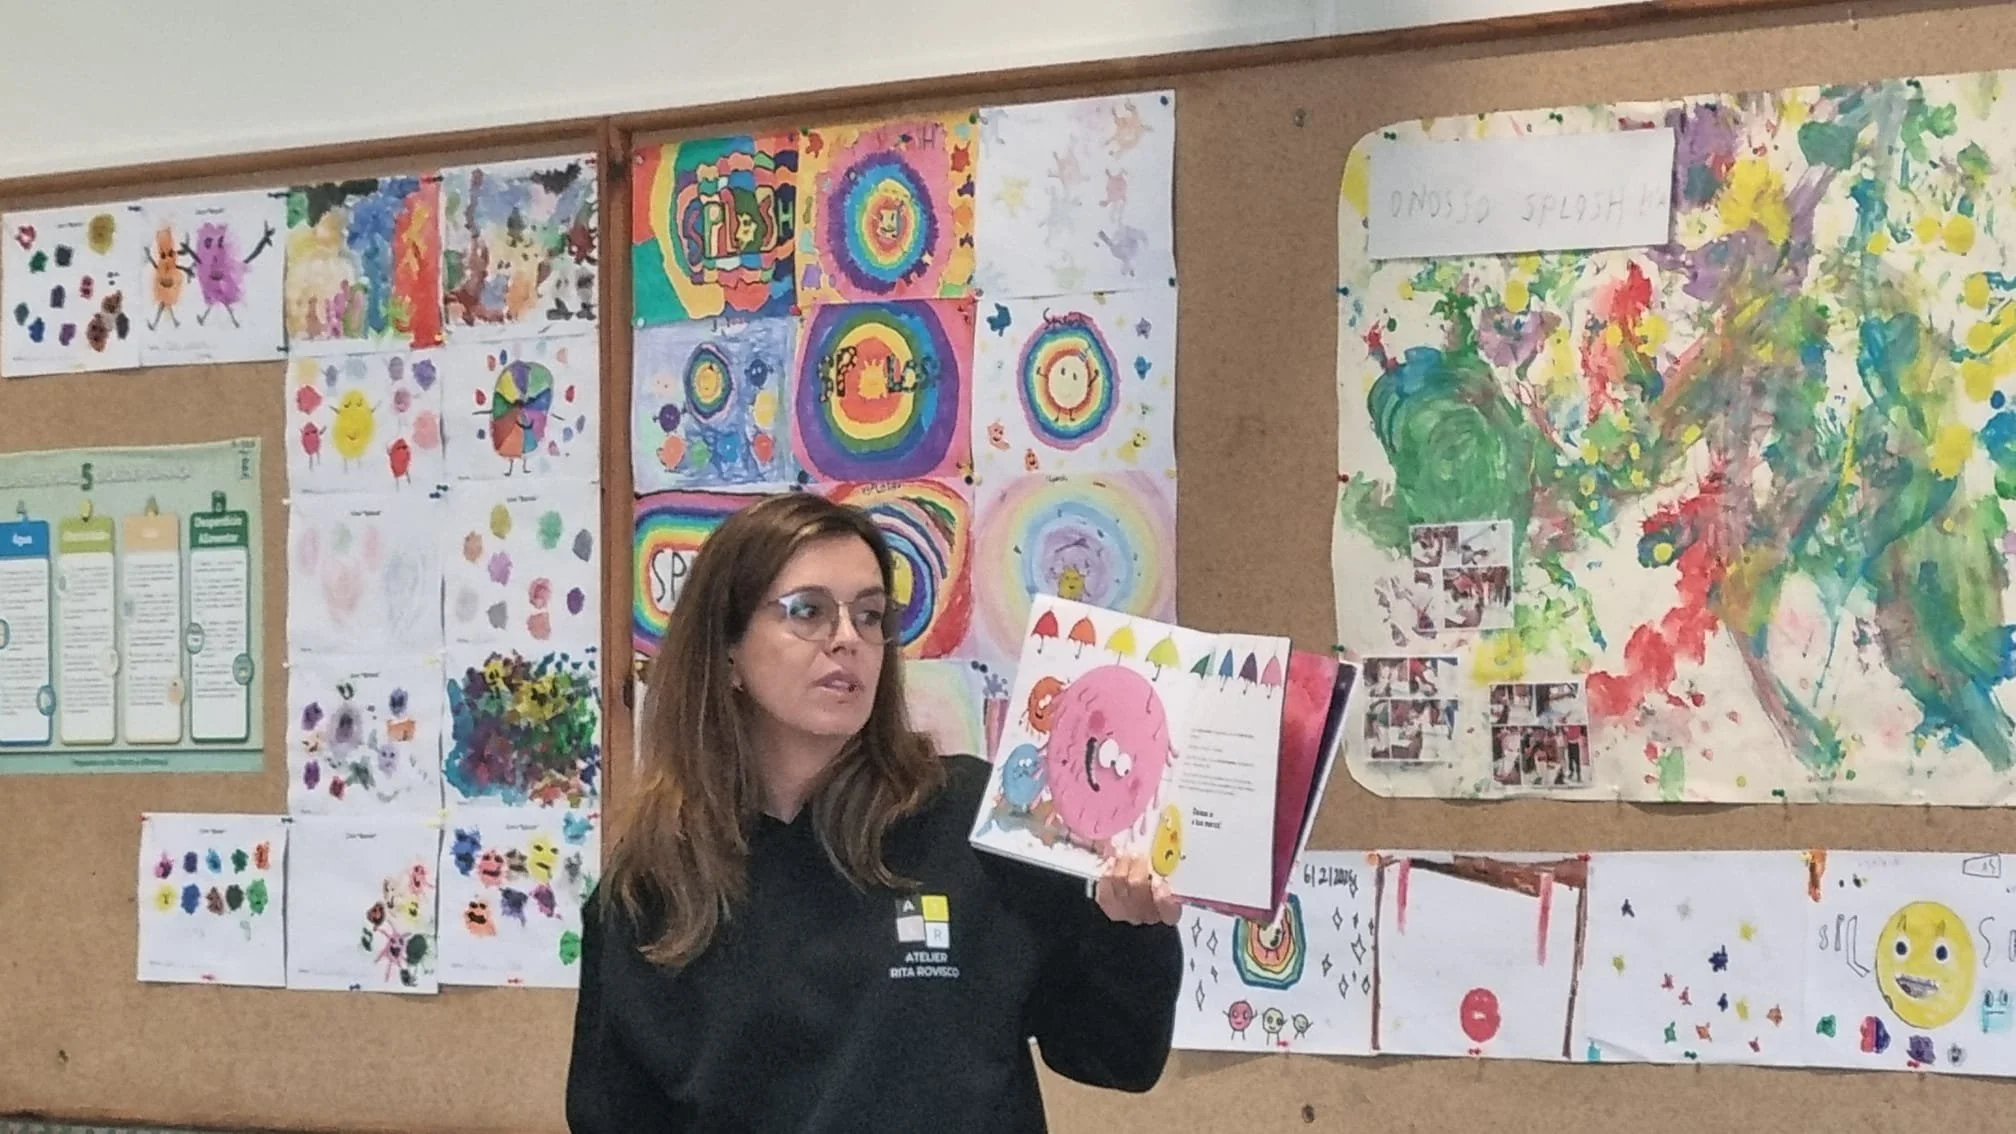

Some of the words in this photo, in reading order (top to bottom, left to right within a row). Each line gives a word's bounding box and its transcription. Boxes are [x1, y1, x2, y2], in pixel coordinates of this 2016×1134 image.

[905, 952, 948, 963] ATELIER
[890, 967, 915, 978] RITA
[916, 966, 960, 978] ROVISCO
